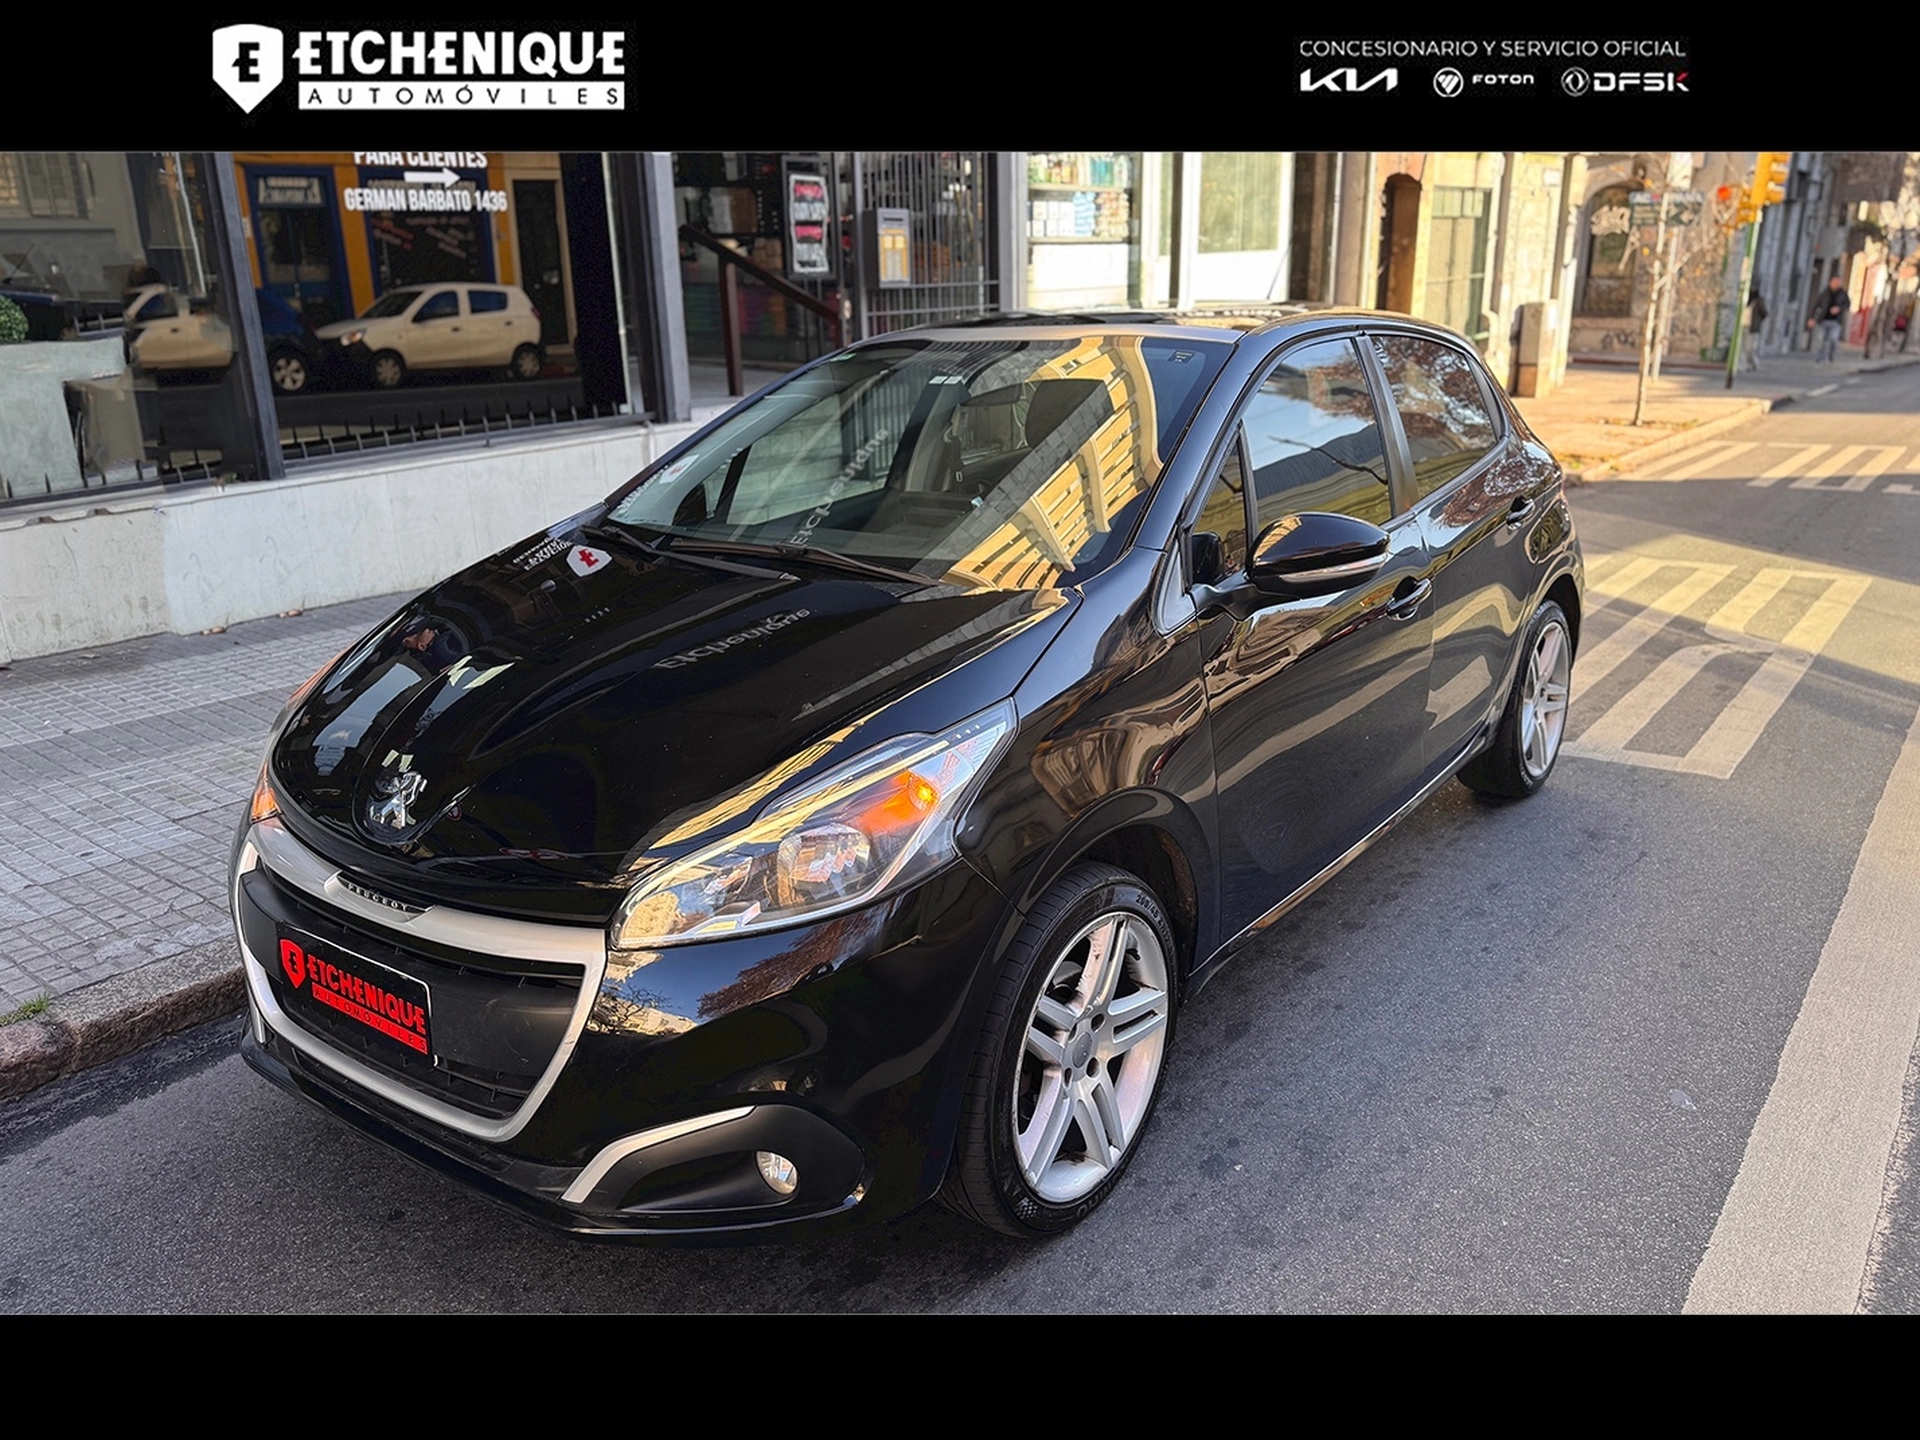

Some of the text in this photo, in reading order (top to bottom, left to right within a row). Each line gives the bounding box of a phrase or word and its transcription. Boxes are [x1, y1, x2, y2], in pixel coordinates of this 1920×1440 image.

[353, 152, 488, 168] PARA CLIENTES
[343, 187, 407, 211] GERMAN
[408, 189, 472, 212] BARBATO
[474, 191, 508, 212] 1436
[347, 883, 409, 912] PEUGEOT
[307, 954, 426, 1034] ETCHENIQUE
